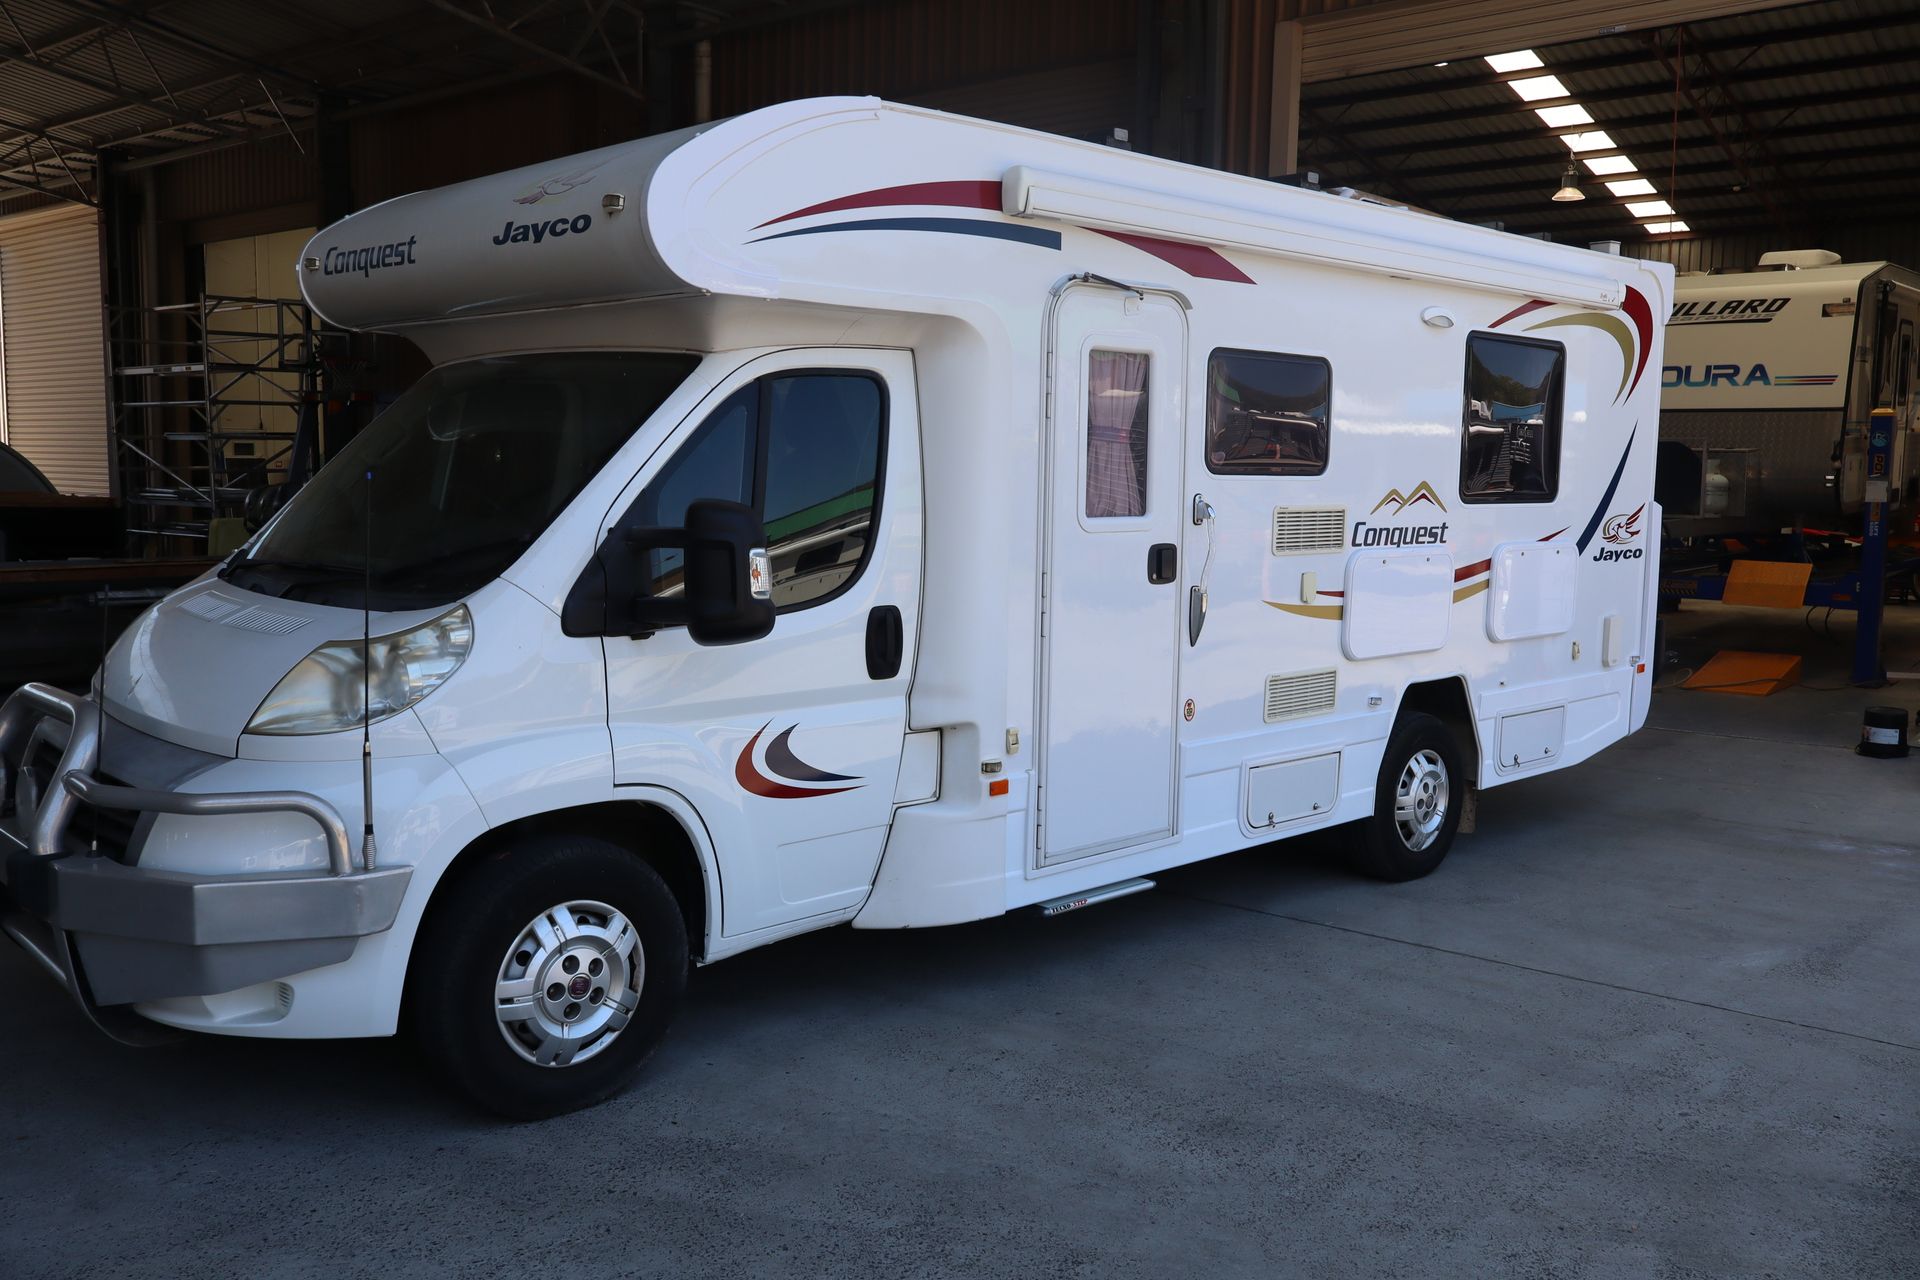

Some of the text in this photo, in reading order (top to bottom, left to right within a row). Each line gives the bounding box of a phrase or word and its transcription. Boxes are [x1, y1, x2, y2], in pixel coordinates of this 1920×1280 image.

[493, 214, 592, 246] Jayco
[324, 235, 416, 278] Conquest
[1671, 297, 1791, 317] ILLARD
[1351, 521, 1449, 548] Conquest
[1592, 546, 1643, 563] Jayco
